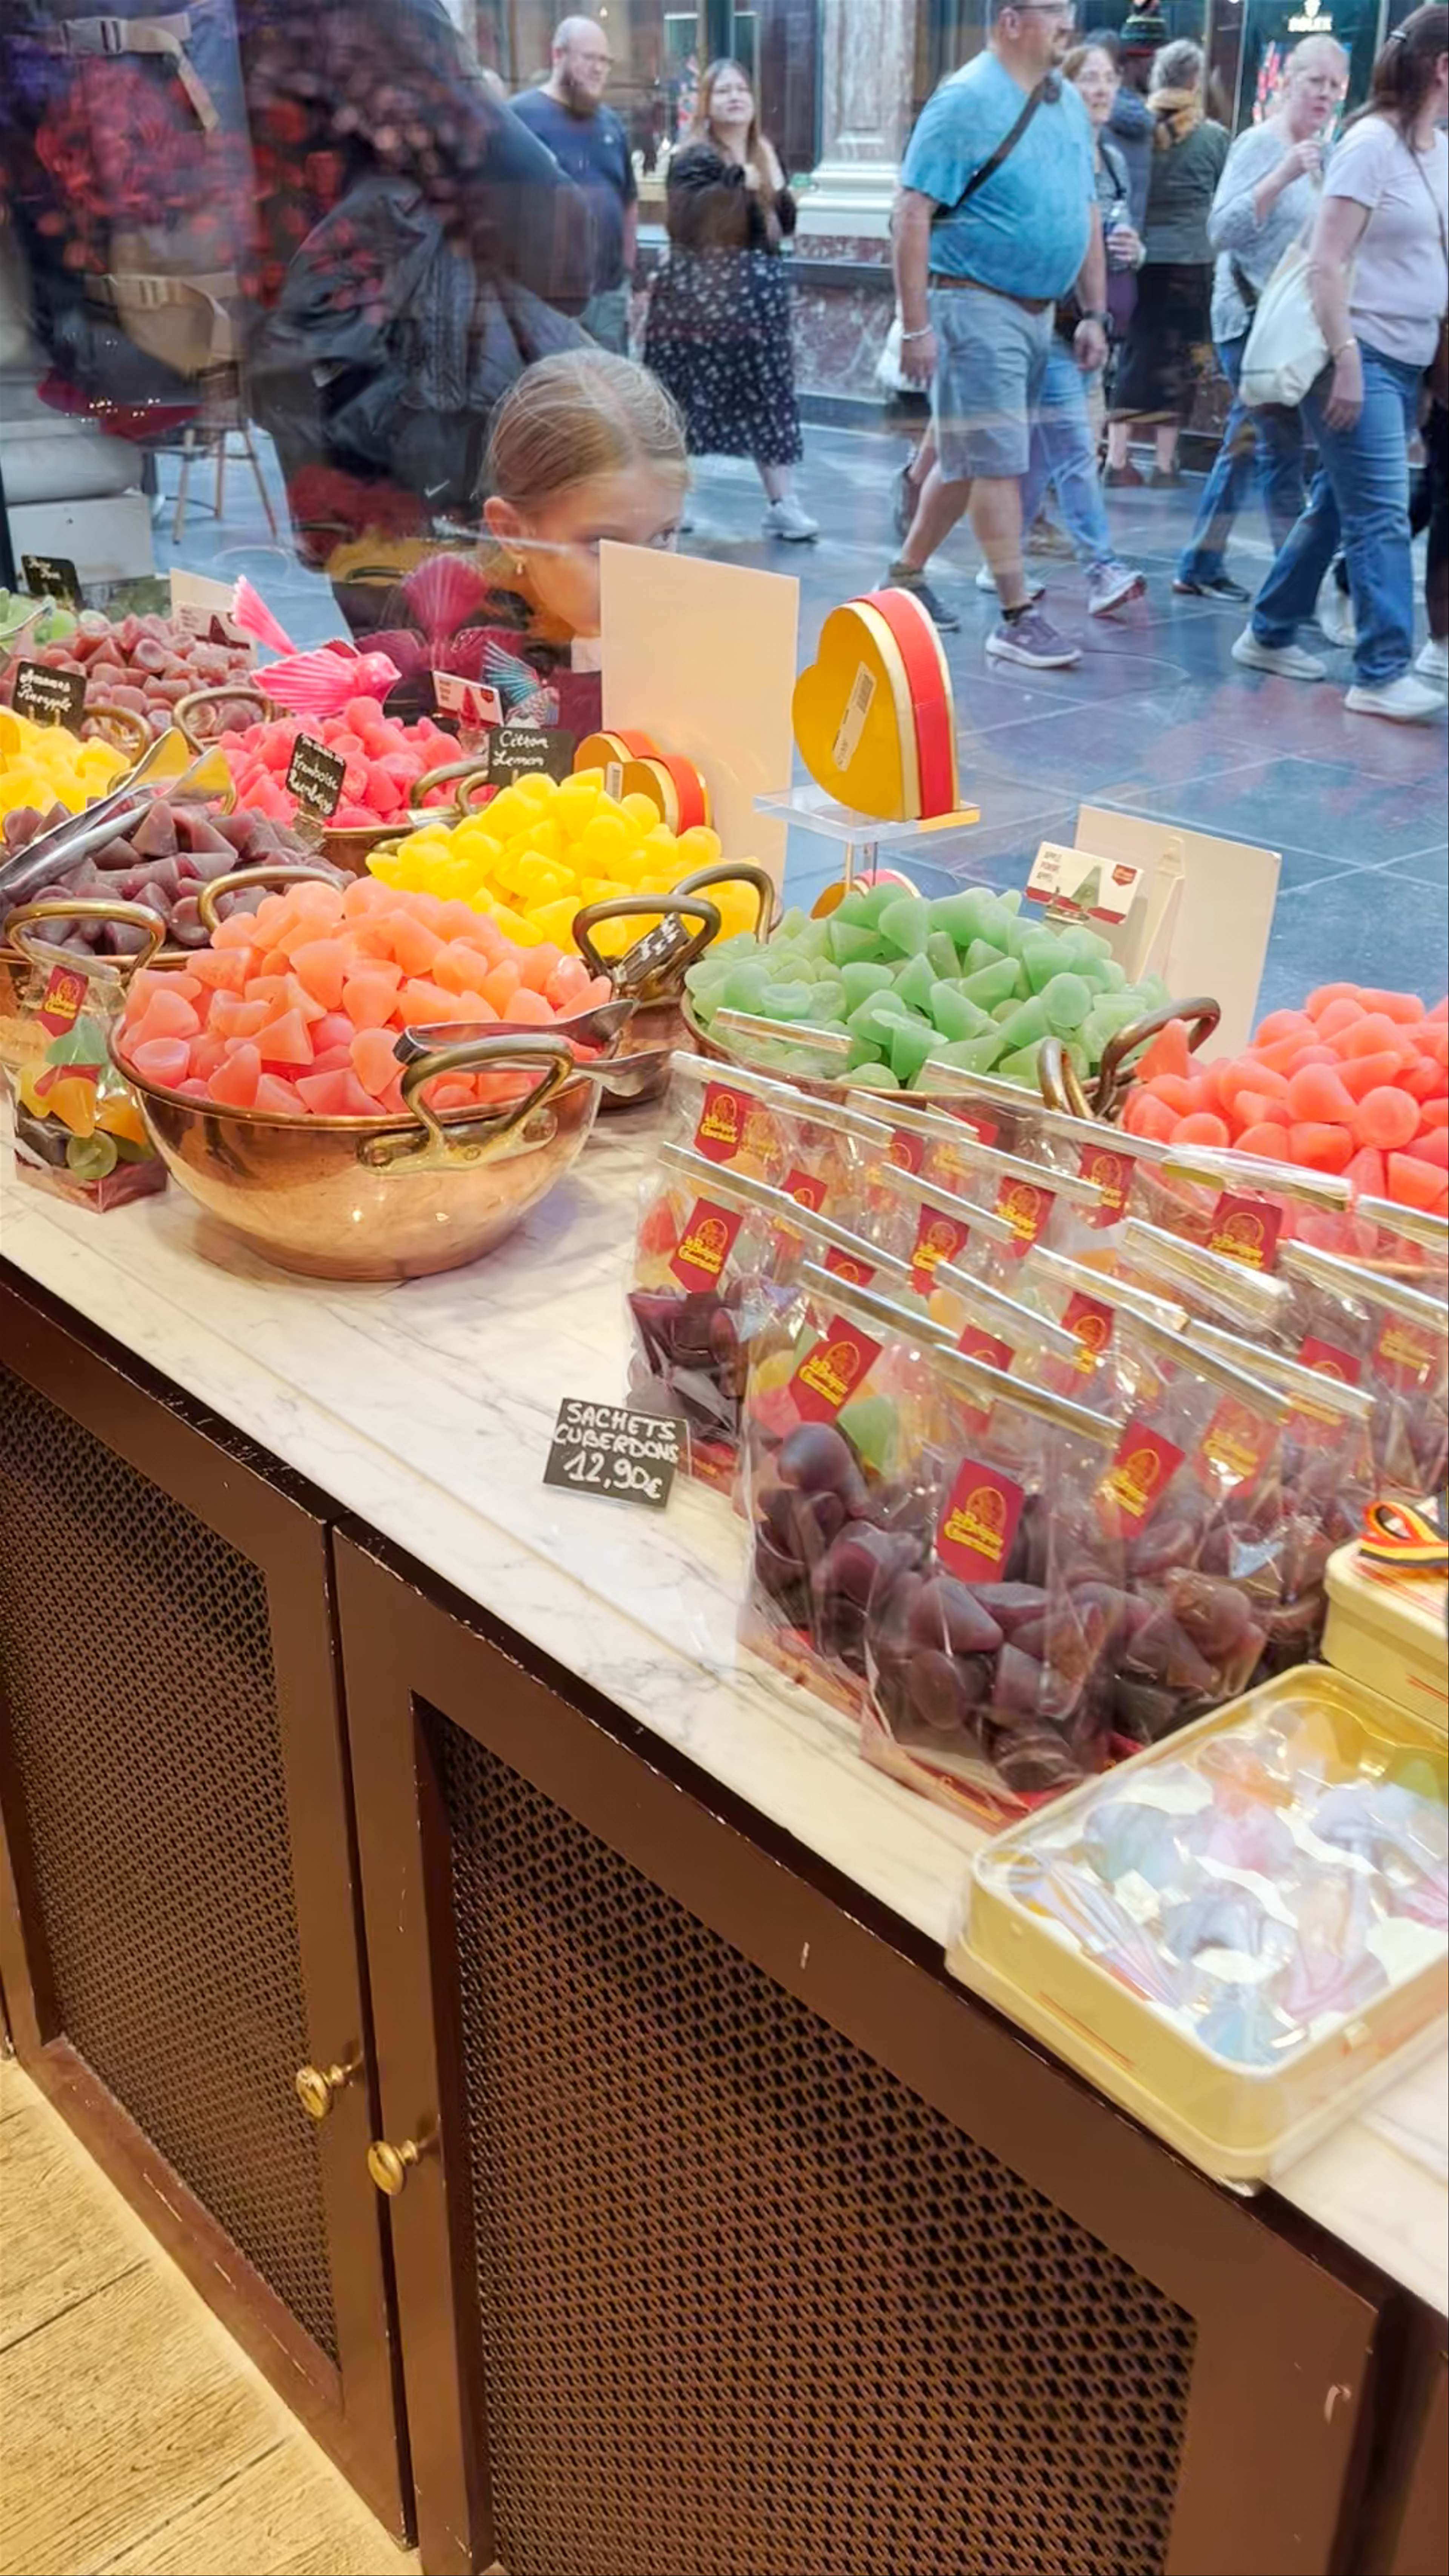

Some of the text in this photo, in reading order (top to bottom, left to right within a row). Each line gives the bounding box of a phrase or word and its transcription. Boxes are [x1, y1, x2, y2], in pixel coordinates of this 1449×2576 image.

[492, 750, 544, 766] Lemon
[499, 731, 549, 749] Citron
[566, 1403, 676, 1441] SACHETS
[553, 1424, 680, 1464] CUBERDONS
[563, 1450, 663, 1499] 12,90€
